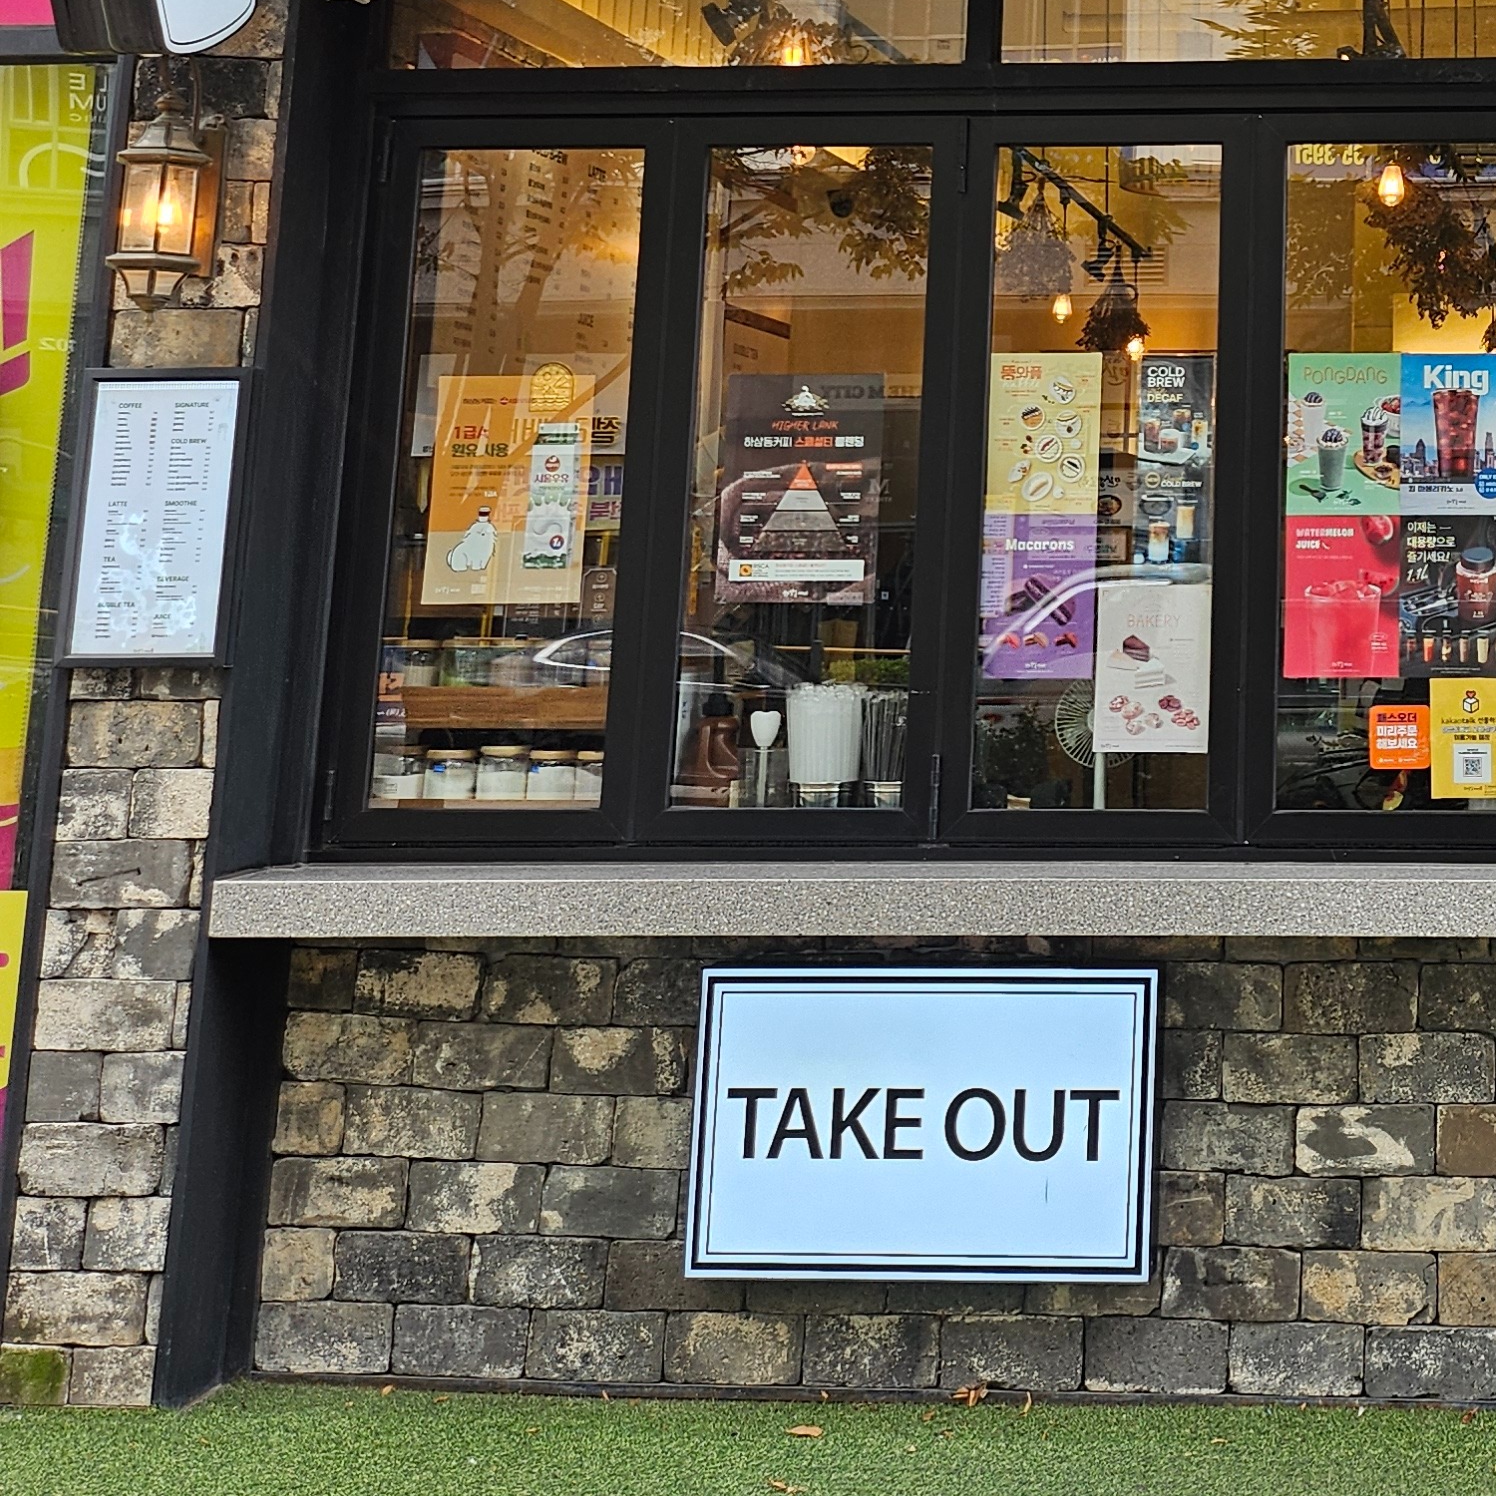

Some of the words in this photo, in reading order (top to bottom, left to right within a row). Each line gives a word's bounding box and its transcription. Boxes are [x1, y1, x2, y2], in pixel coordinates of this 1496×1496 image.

[1147, 366, 1186, 377] COLD
[1147, 377, 1186, 388] BREW
[1423, 364, 1490, 396] King
[1147, 393, 1184, 403] DECAF
[743, 436, 793, 448] 하삼동커피
[1295, 528, 1355, 538] WATERMELON
[1407, 521, 1437, 534] 이제는
[1005, 538, 1075, 552] Macarons
[1295, 540, 1321, 550] JUICE
[1406, 536, 1457, 549] 대용량으로
[1406, 550, 1451, 563] 즐기세요!
[1127, 613, 1181, 628] BAKERY
[1376, 725, 1419, 737] 미리주문
[727, 1087, 926, 1160] TAKE
[944, 1087, 1121, 1163] OUT
